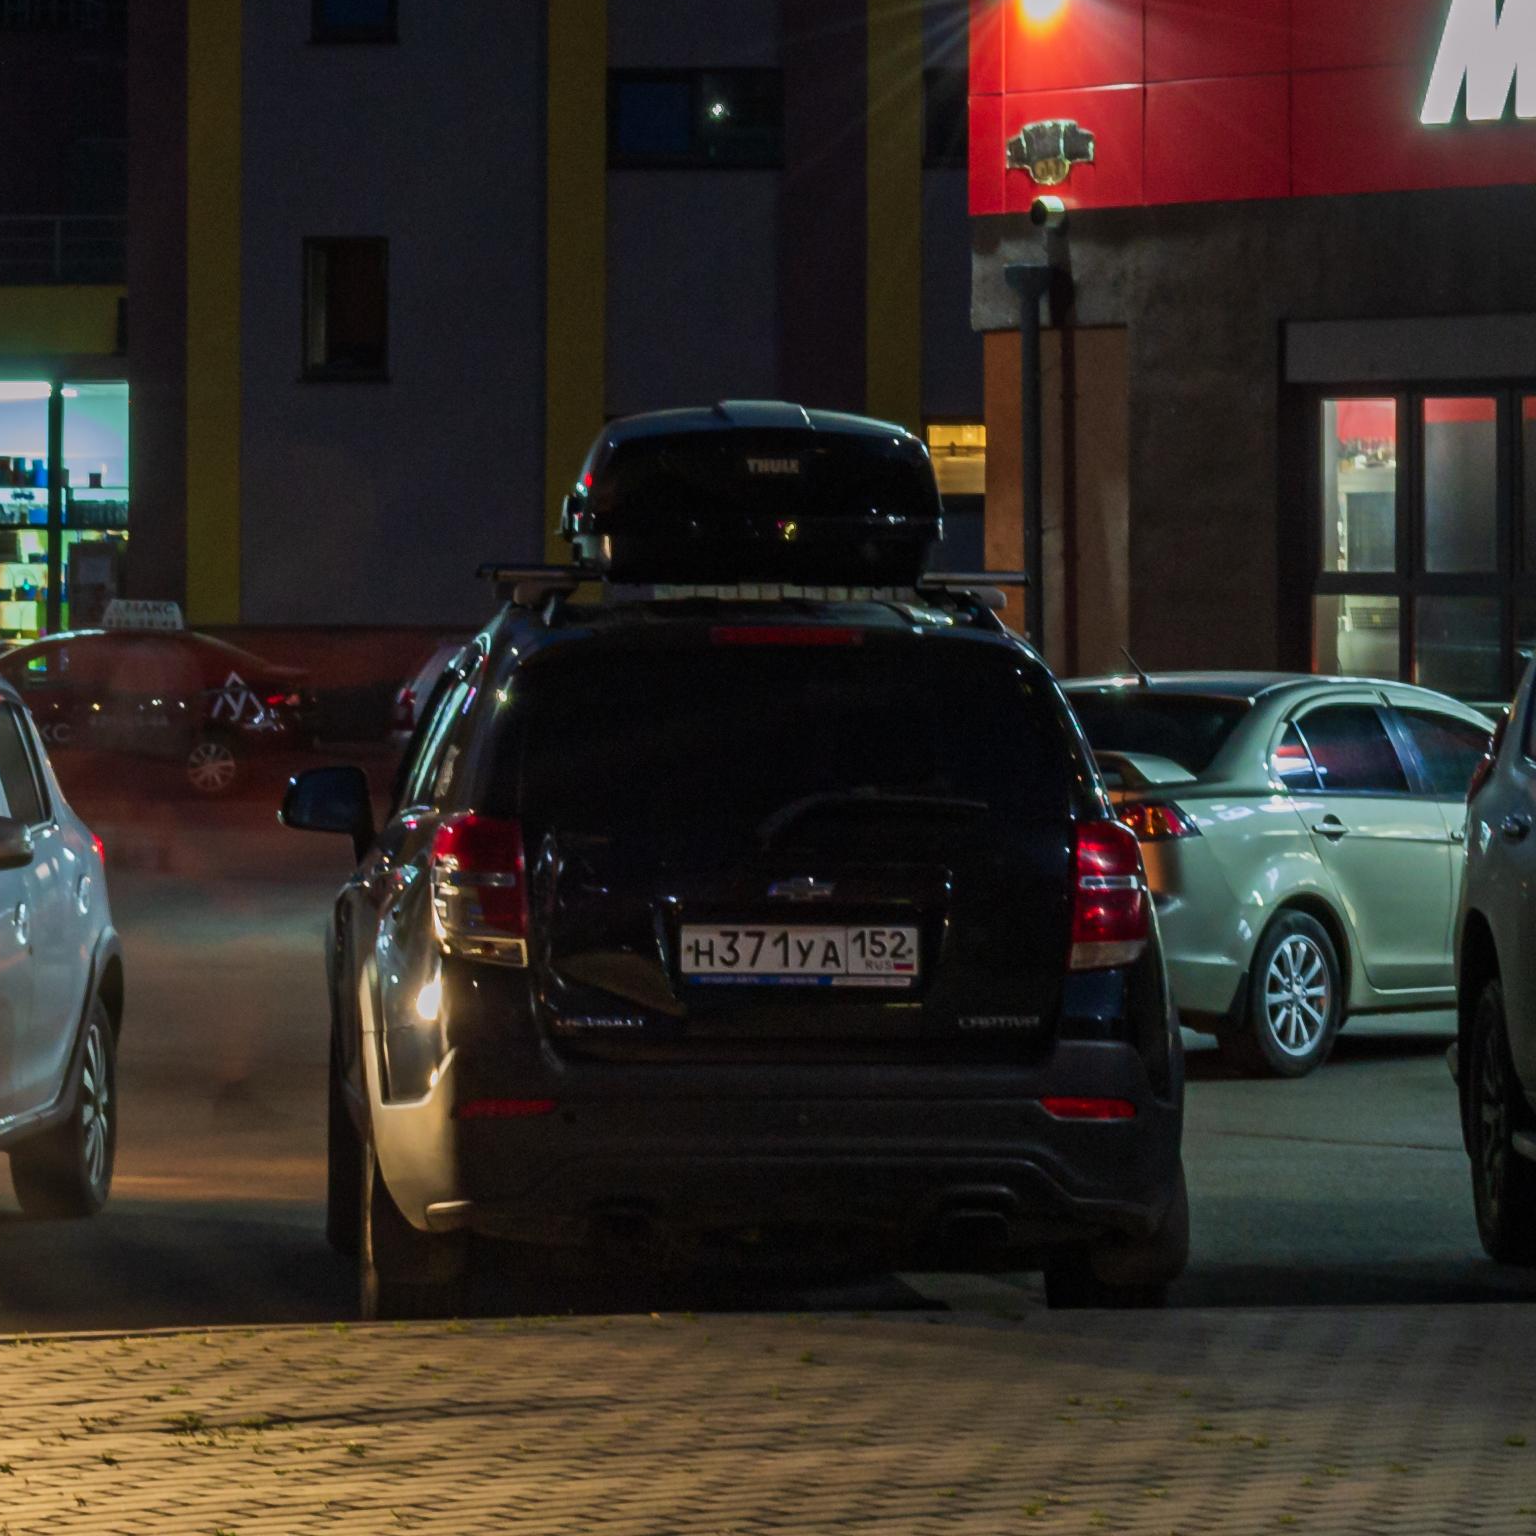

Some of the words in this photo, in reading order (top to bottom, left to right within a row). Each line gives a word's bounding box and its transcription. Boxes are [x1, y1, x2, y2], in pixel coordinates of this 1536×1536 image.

[693, 930, 842, 968] Н371УА
[851, 930, 907, 959] 152
[865, 959, 893, 971] RUS
